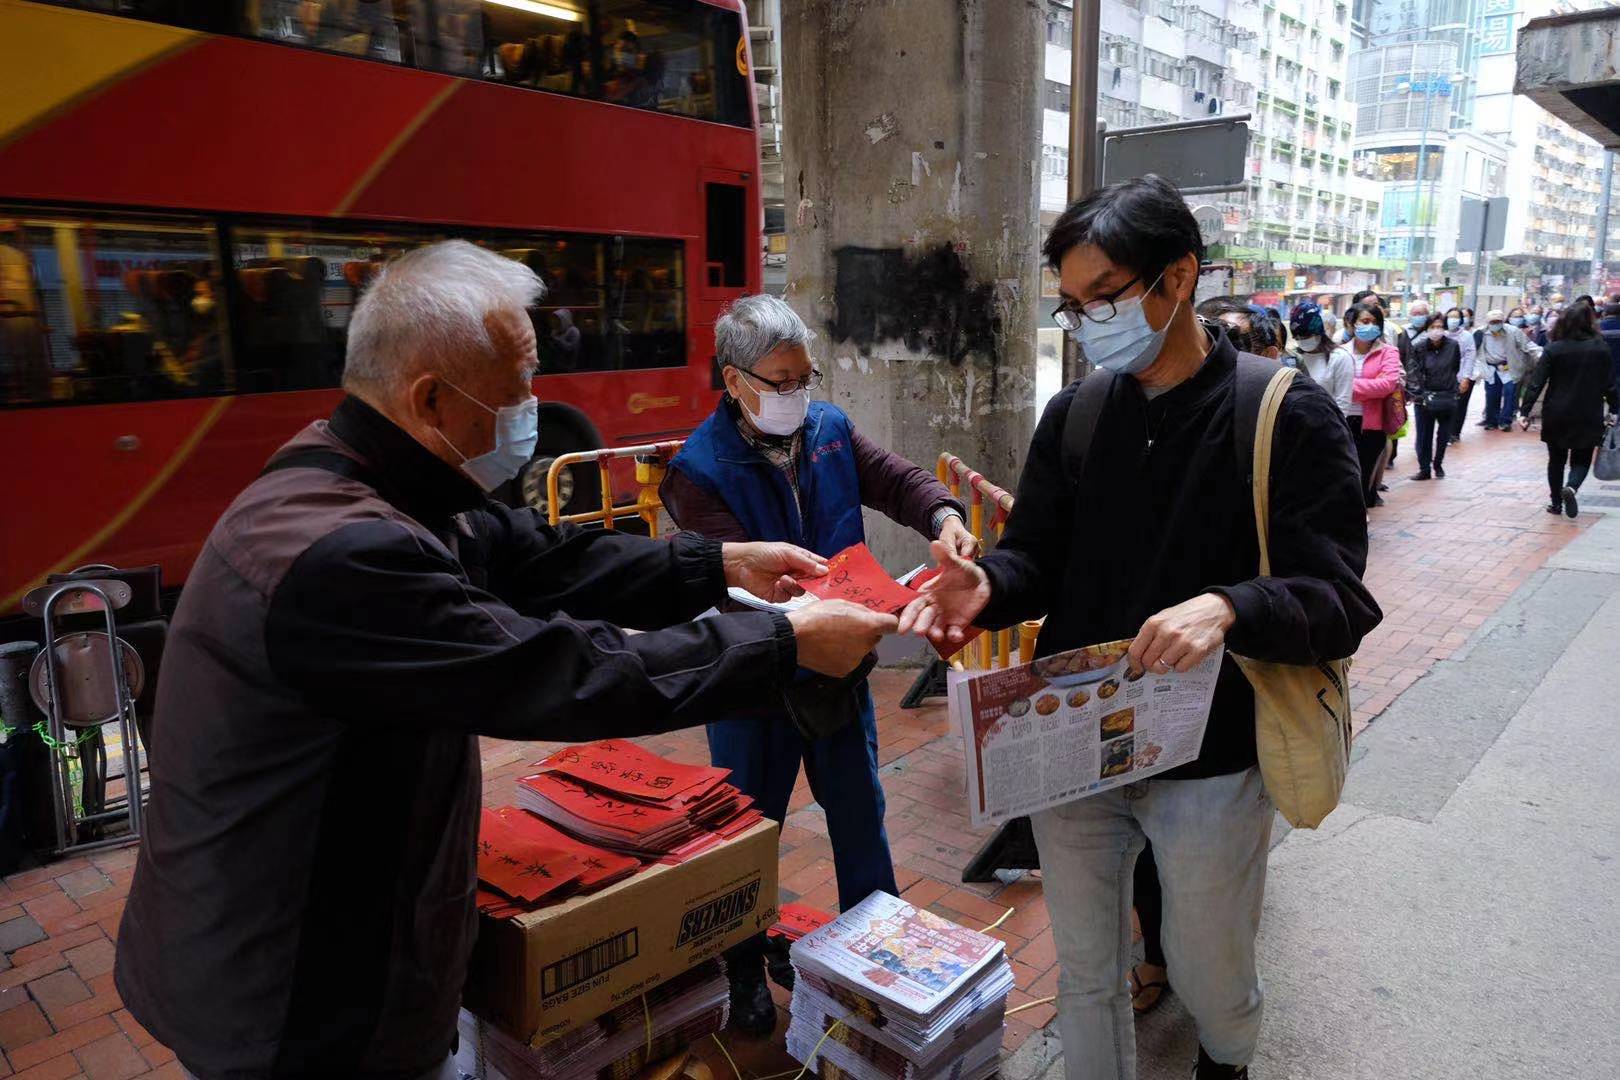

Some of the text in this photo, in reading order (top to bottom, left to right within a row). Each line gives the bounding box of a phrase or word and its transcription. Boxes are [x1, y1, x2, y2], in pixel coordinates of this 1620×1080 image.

[682, 882, 758, 941] SNICKERS
[592, 974, 610, 989] FUN
[571, 983, 592, 999] SIZE
[543, 993, 569, 1010] BAGS
